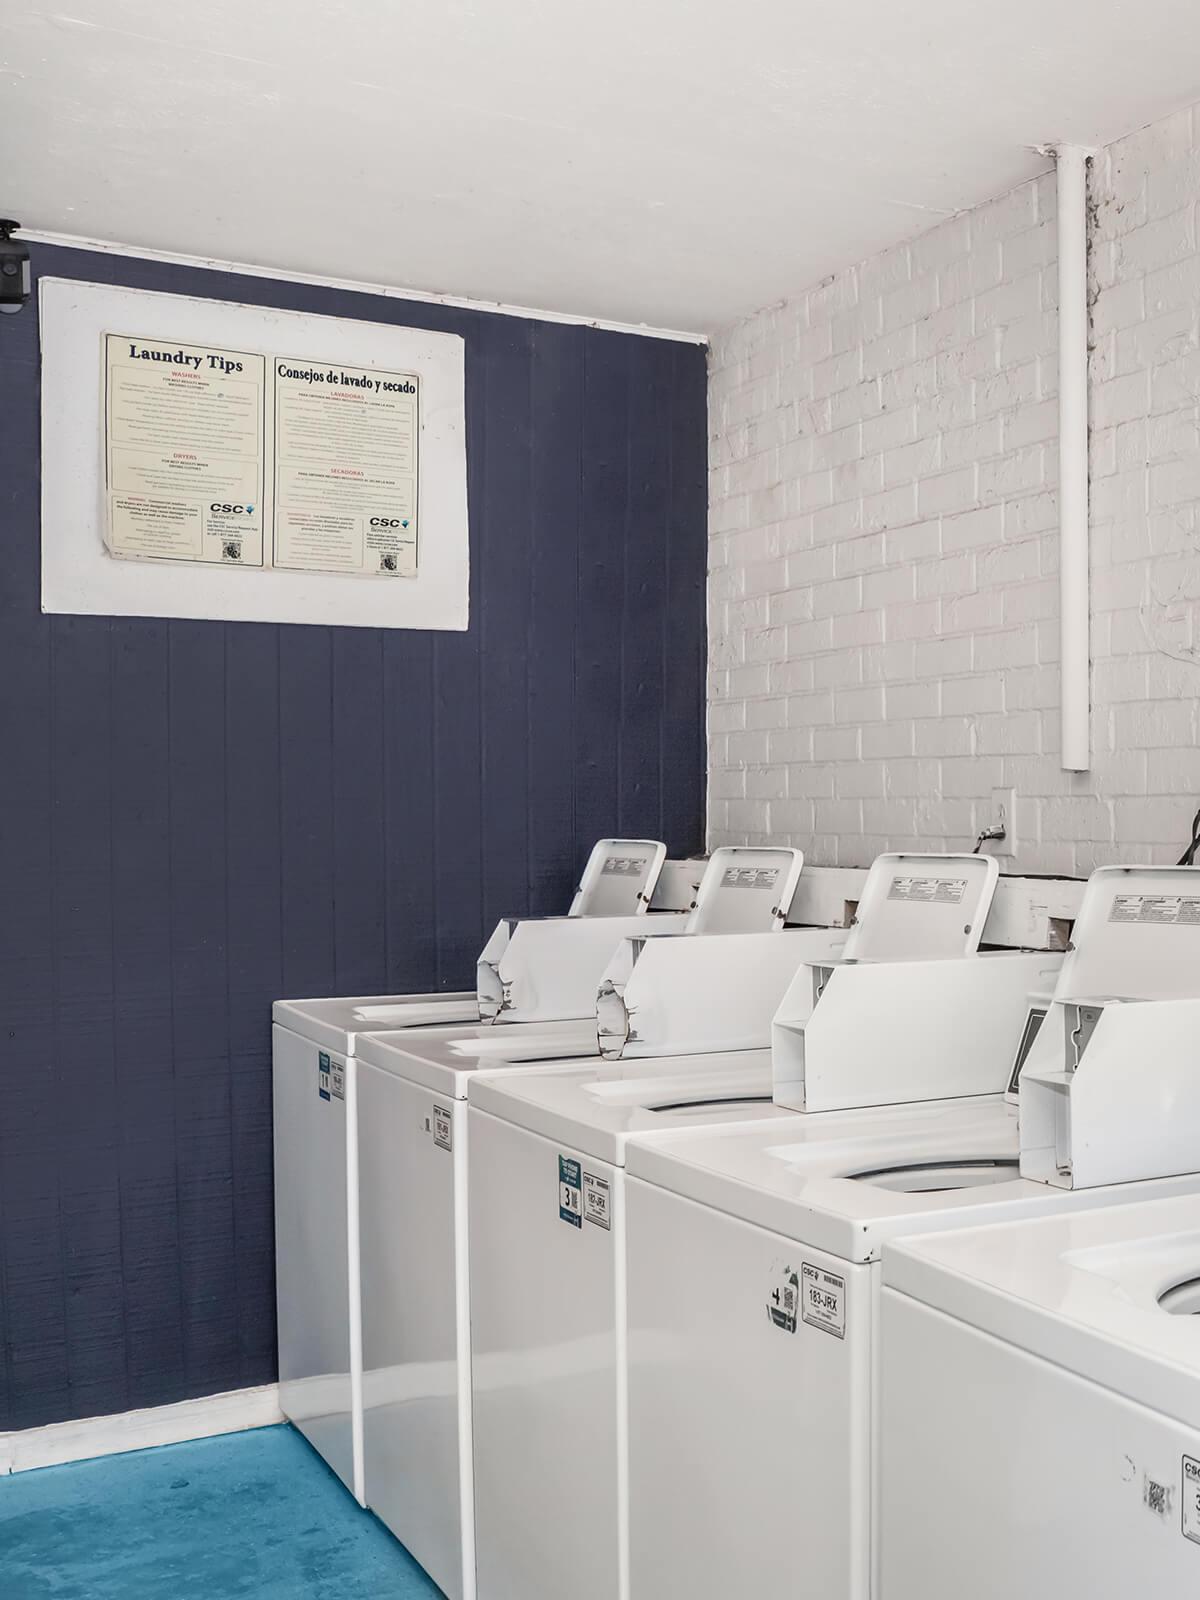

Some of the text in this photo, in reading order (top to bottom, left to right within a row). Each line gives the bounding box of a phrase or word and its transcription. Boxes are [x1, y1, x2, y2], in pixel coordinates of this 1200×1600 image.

[129, 344, 243, 374] Laundry Tips
[171, 371, 201, 379] WASHERS
[278, 364, 416, 394] Consejos de lavado y secado
[330, 392, 365, 400] LAVADORAS
[330, 468, 364, 476] SECADORAS
[210, 503, 244, 514] CSC
[370, 517, 400, 528] CSC
[565, 1187, 570, 1206] 3
[803, 1267, 814, 1277] CSC
[771, 1287, 780, 1305] 4
